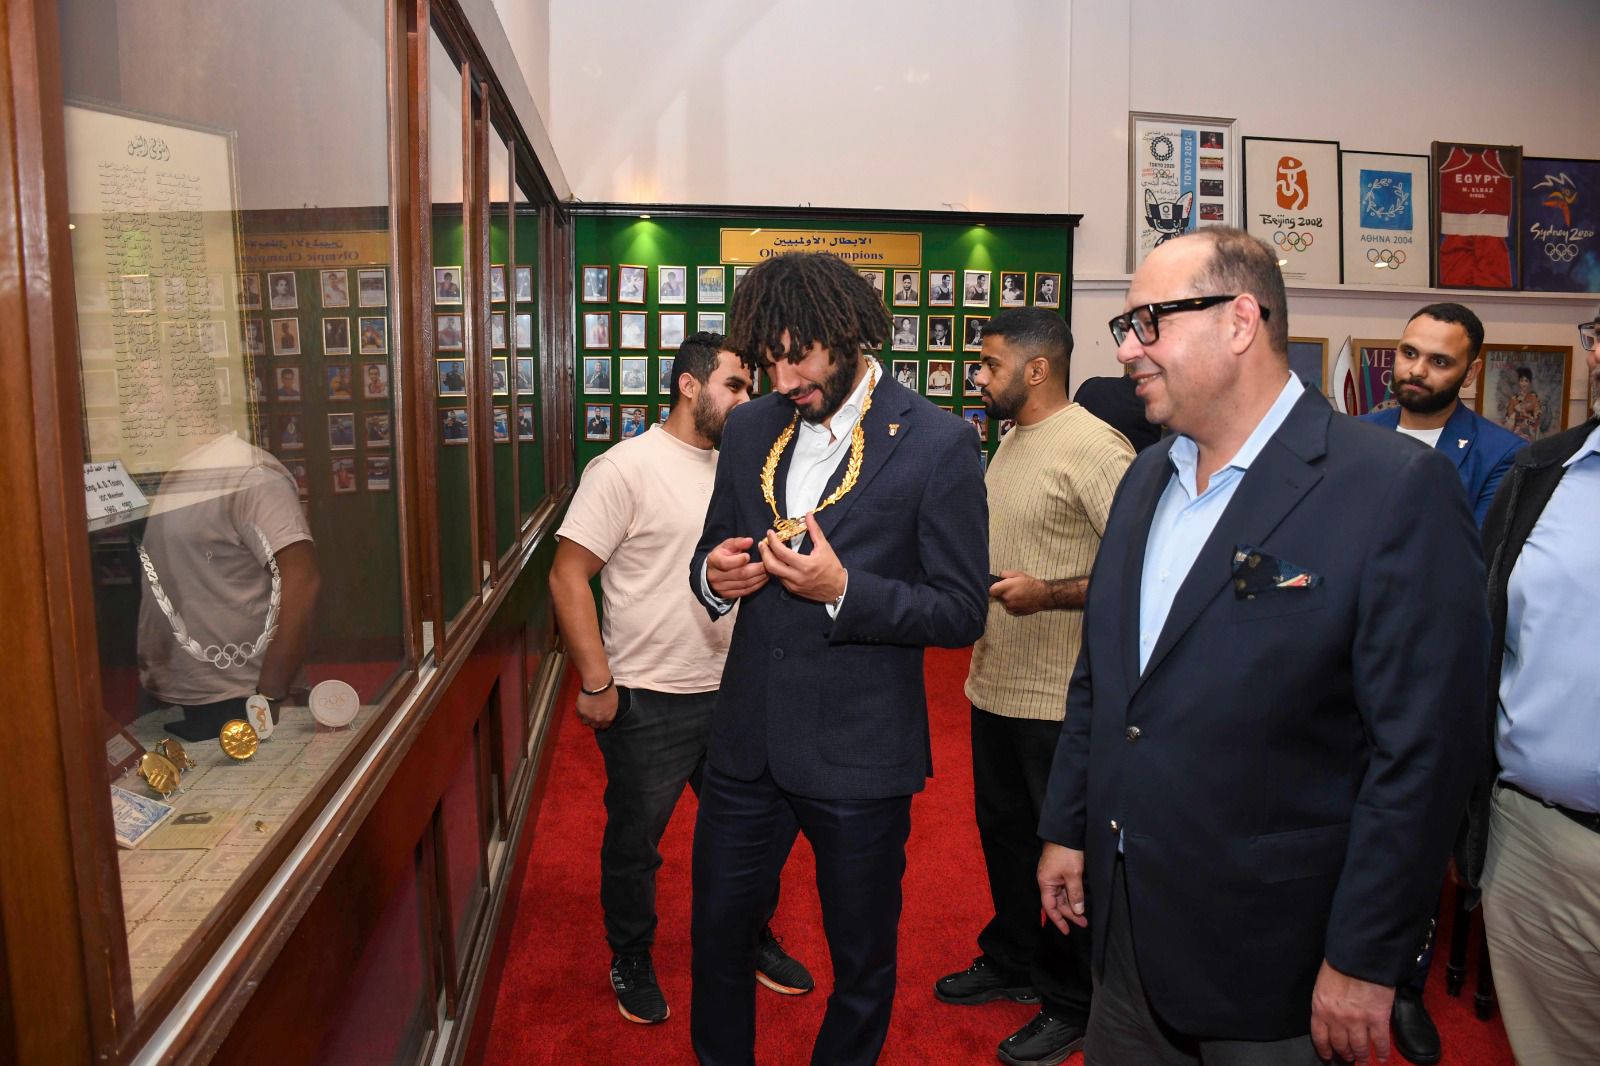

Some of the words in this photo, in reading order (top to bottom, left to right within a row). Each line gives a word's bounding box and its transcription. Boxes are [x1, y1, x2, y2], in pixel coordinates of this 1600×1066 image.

[1184, 158, 1193, 186] TOKYO
[1455, 173, 1500, 185] EGYPT
[1259, 214, 1296, 229] Beijing
[1297, 217, 1323, 228] 2008
[1530, 222, 1569, 243] Sydney
[1569, 228, 1595, 241] 2000
[1393, 236, 1413, 244] 2004
[816, 249, 884, 261] Cmpions
